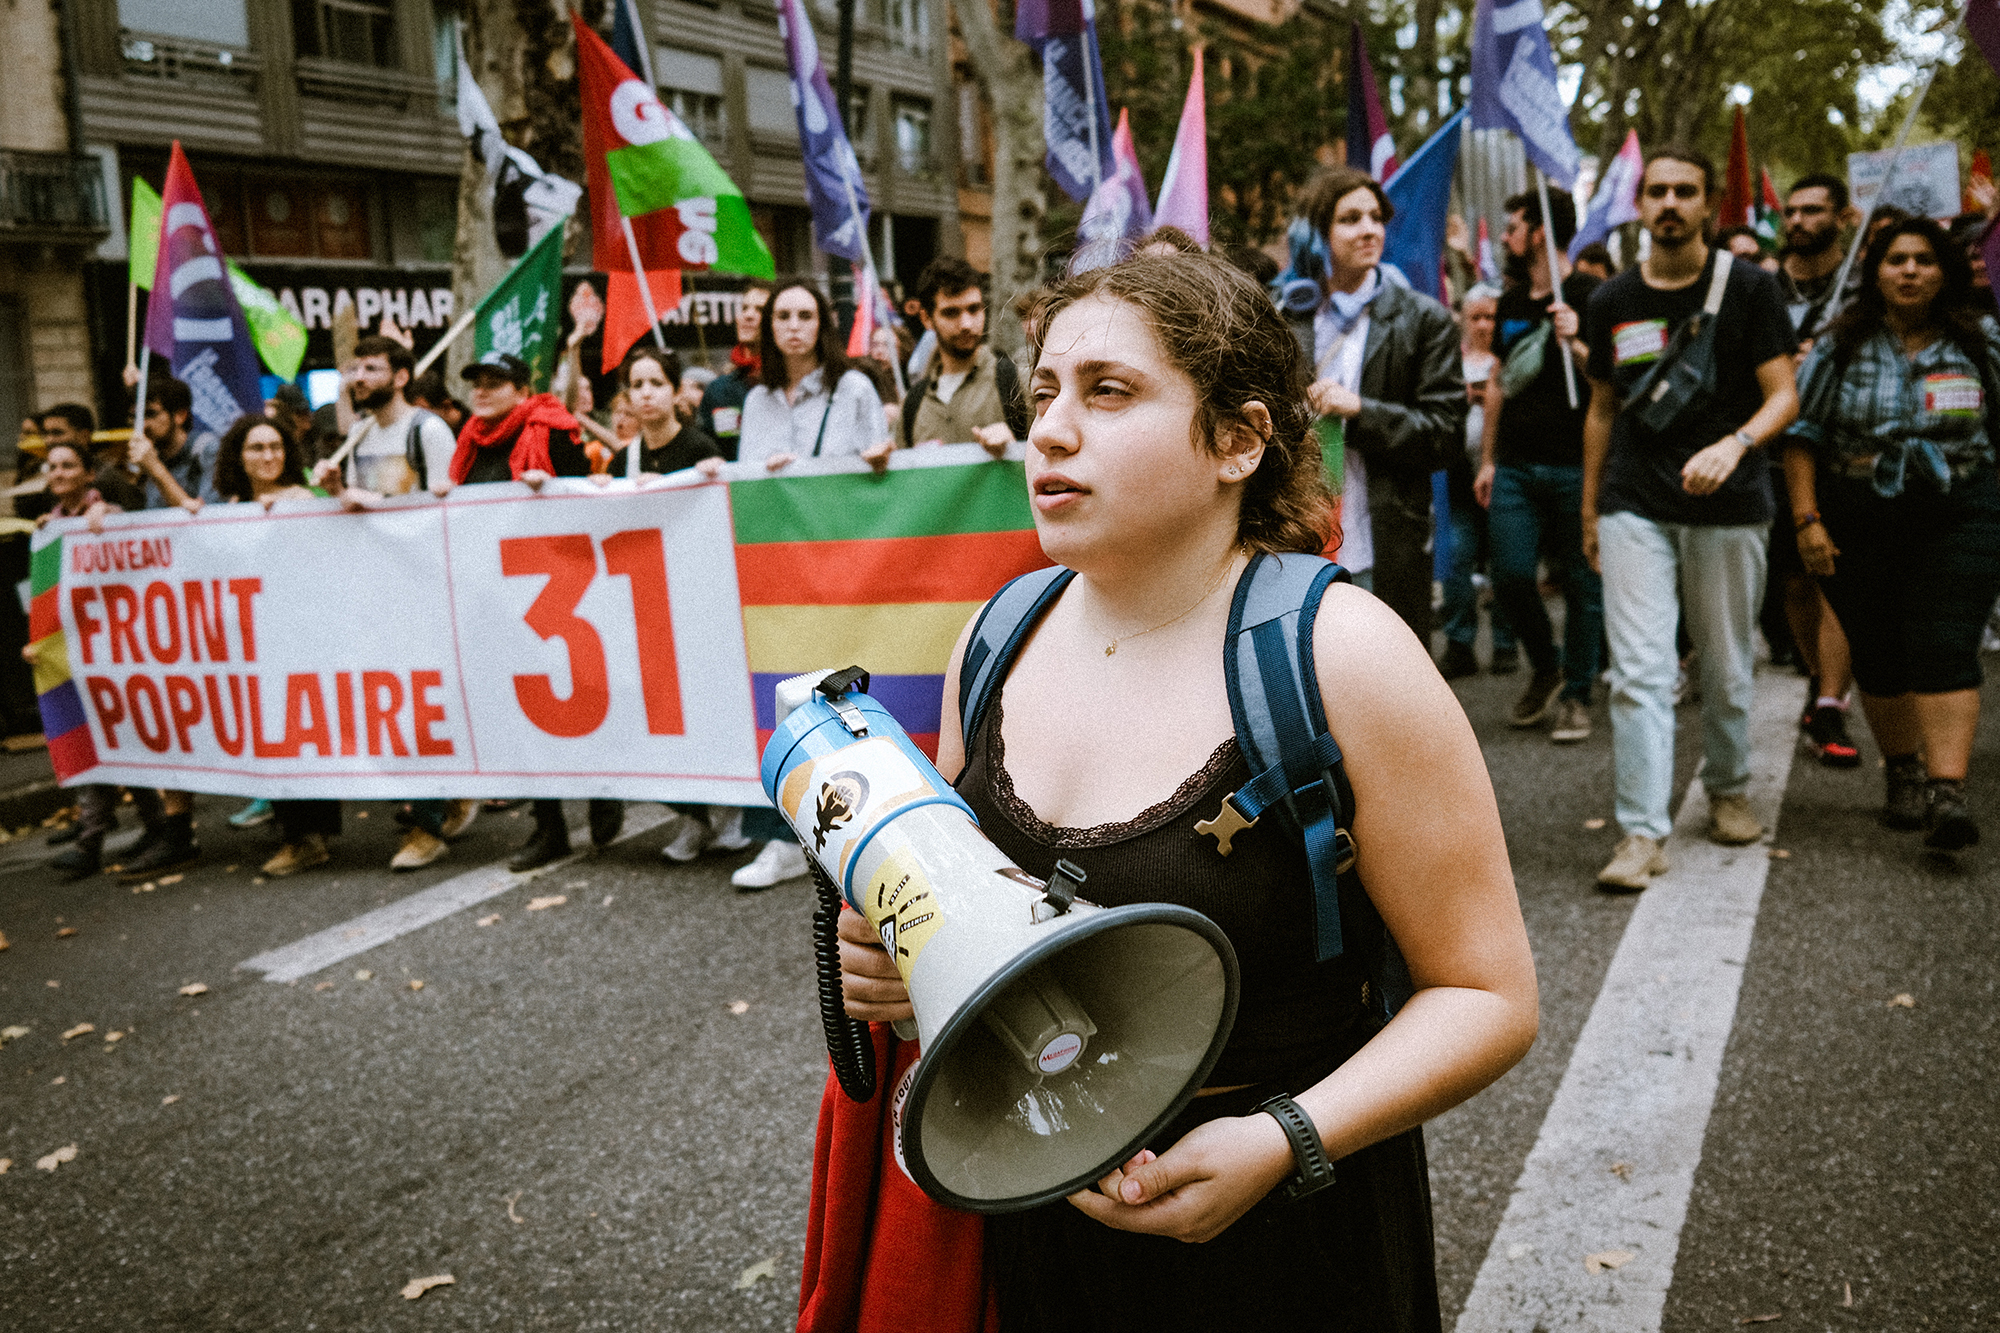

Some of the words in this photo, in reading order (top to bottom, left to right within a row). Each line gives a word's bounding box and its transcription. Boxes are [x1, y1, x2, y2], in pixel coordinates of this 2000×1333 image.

[262, 286, 454, 330] ARAPHAR
[70, 577, 263, 665] FRONT
[499, 527, 686, 739] 31
[85, 670, 455, 759] POPULAIRE
[895, 1073, 912, 1105] TOUT
